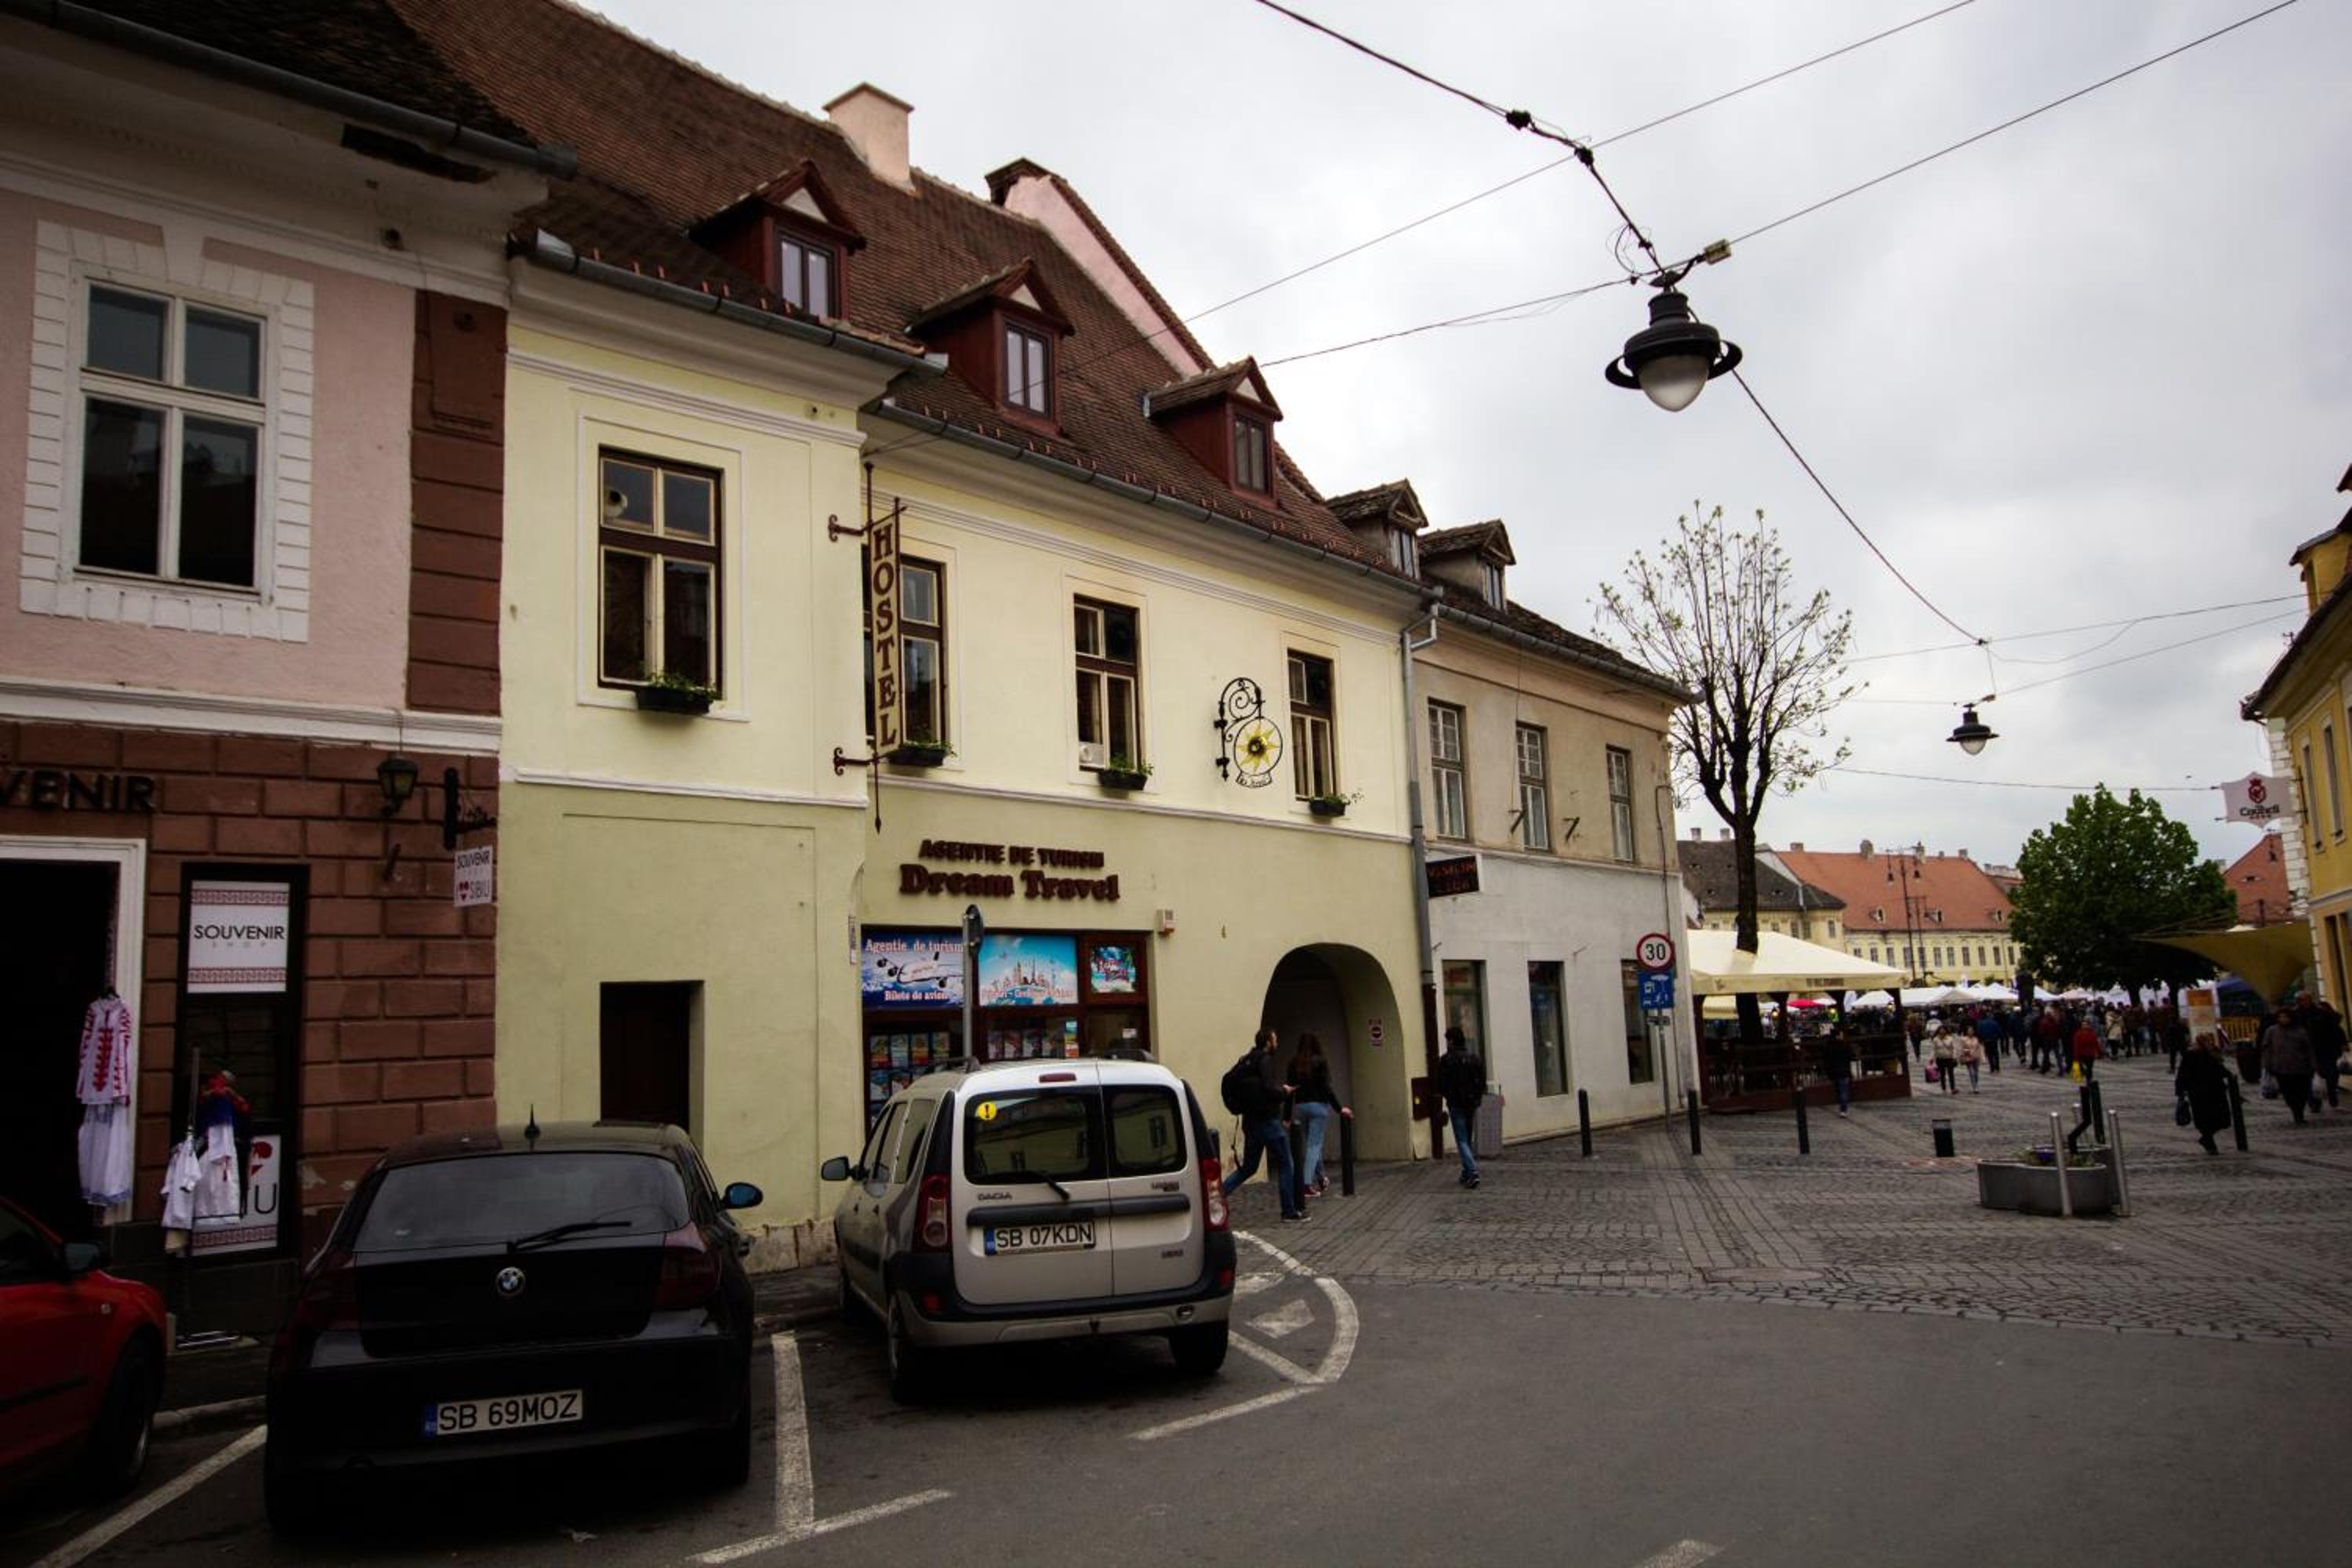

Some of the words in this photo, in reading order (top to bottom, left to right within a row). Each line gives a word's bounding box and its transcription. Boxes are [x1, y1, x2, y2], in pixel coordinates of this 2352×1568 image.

[873, 524, 897, 747] HOSTEL
[457, 850, 490, 869] SOUVENIR
[918, 840, 1005, 862] AGENTIE
[1009, 846, 1034, 865] DE
[1037, 848, 1104, 868] TURISM
[899, 863, 1014, 897] Dream
[1021, 869, 1120, 902] Travel
[194, 924, 285, 940] SOUVENIR
[913, 939, 925, 953] de
[1645, 943, 1666, 960] 30
[912, 991, 924, 1000] de
[996, 1229, 1023, 1248] SB
[1029, 1222, 1092, 1246] 07KDN
[439, 1404, 477, 1431] SB
[488, 1393, 578, 1427] 69MOZ
